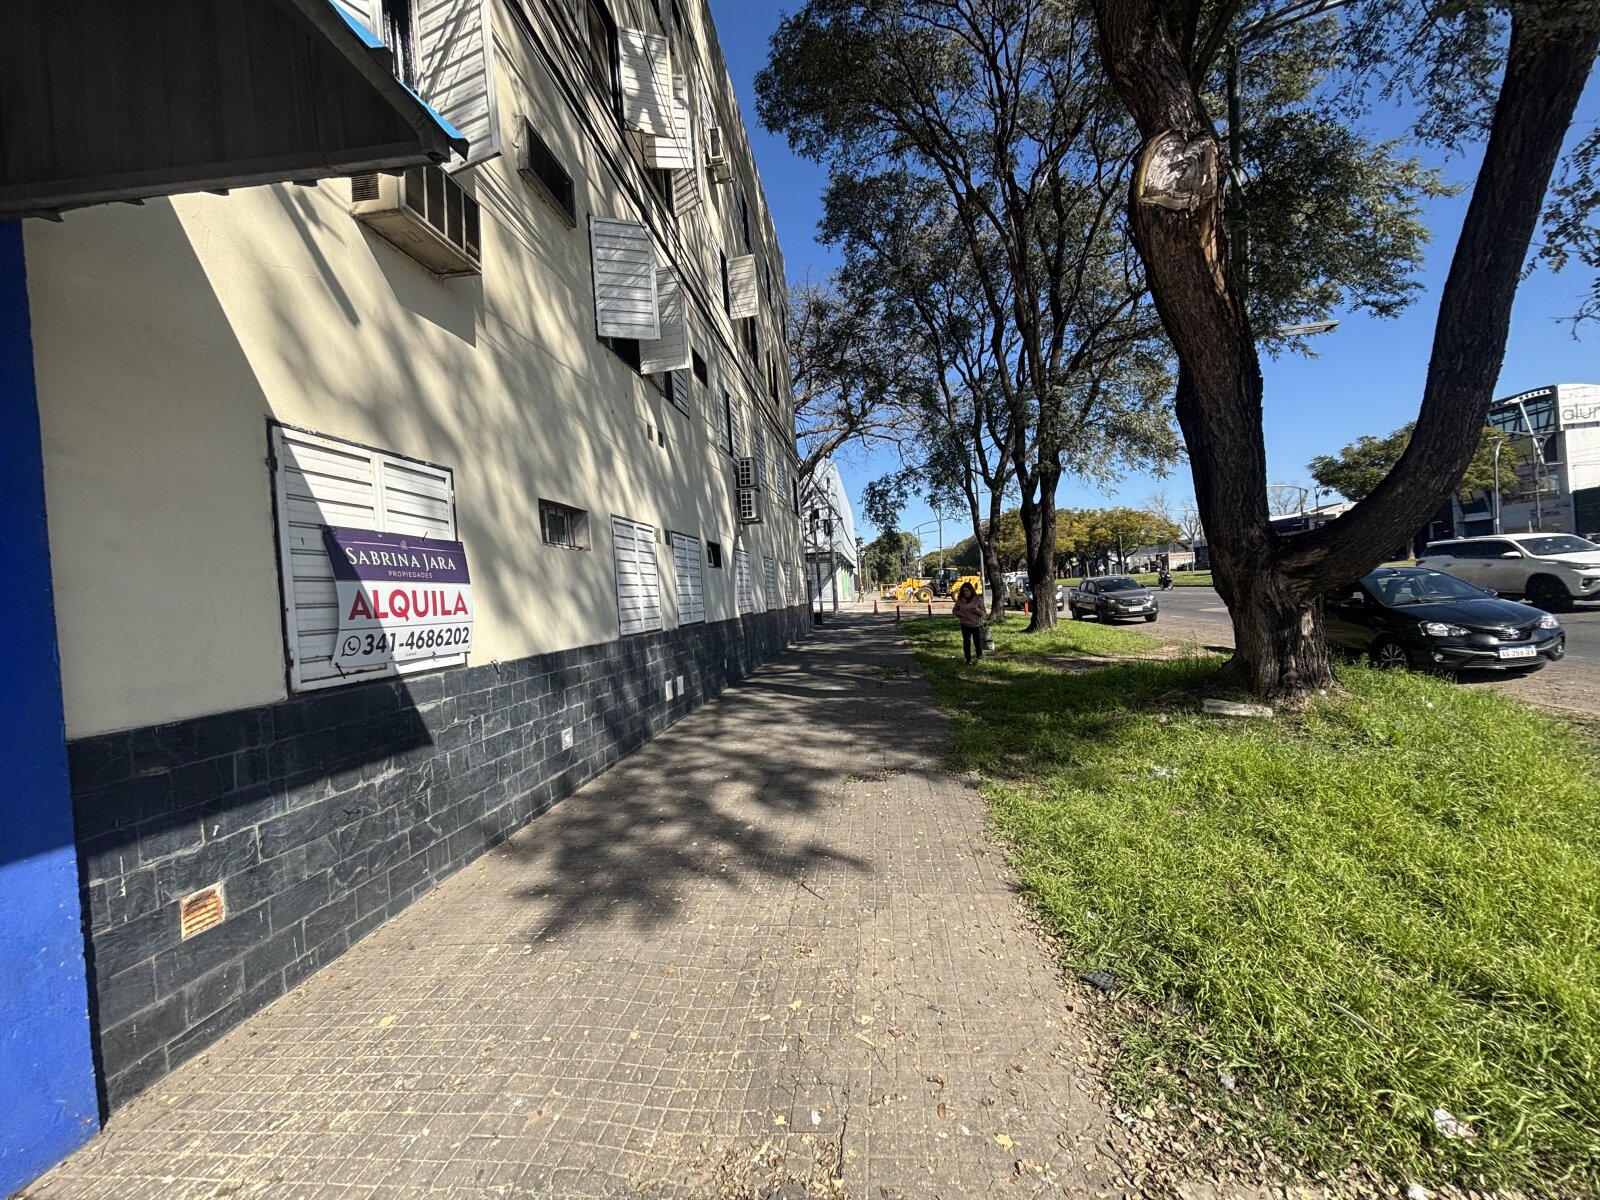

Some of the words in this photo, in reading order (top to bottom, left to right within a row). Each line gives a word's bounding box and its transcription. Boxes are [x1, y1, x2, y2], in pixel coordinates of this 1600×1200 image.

[422, 553, 456, 571] JARA
[388, 570, 433, 579] PROPIEDADES
[348, 588, 469, 622] ALQUILA
[362, 626, 470, 655] 341-4686202
